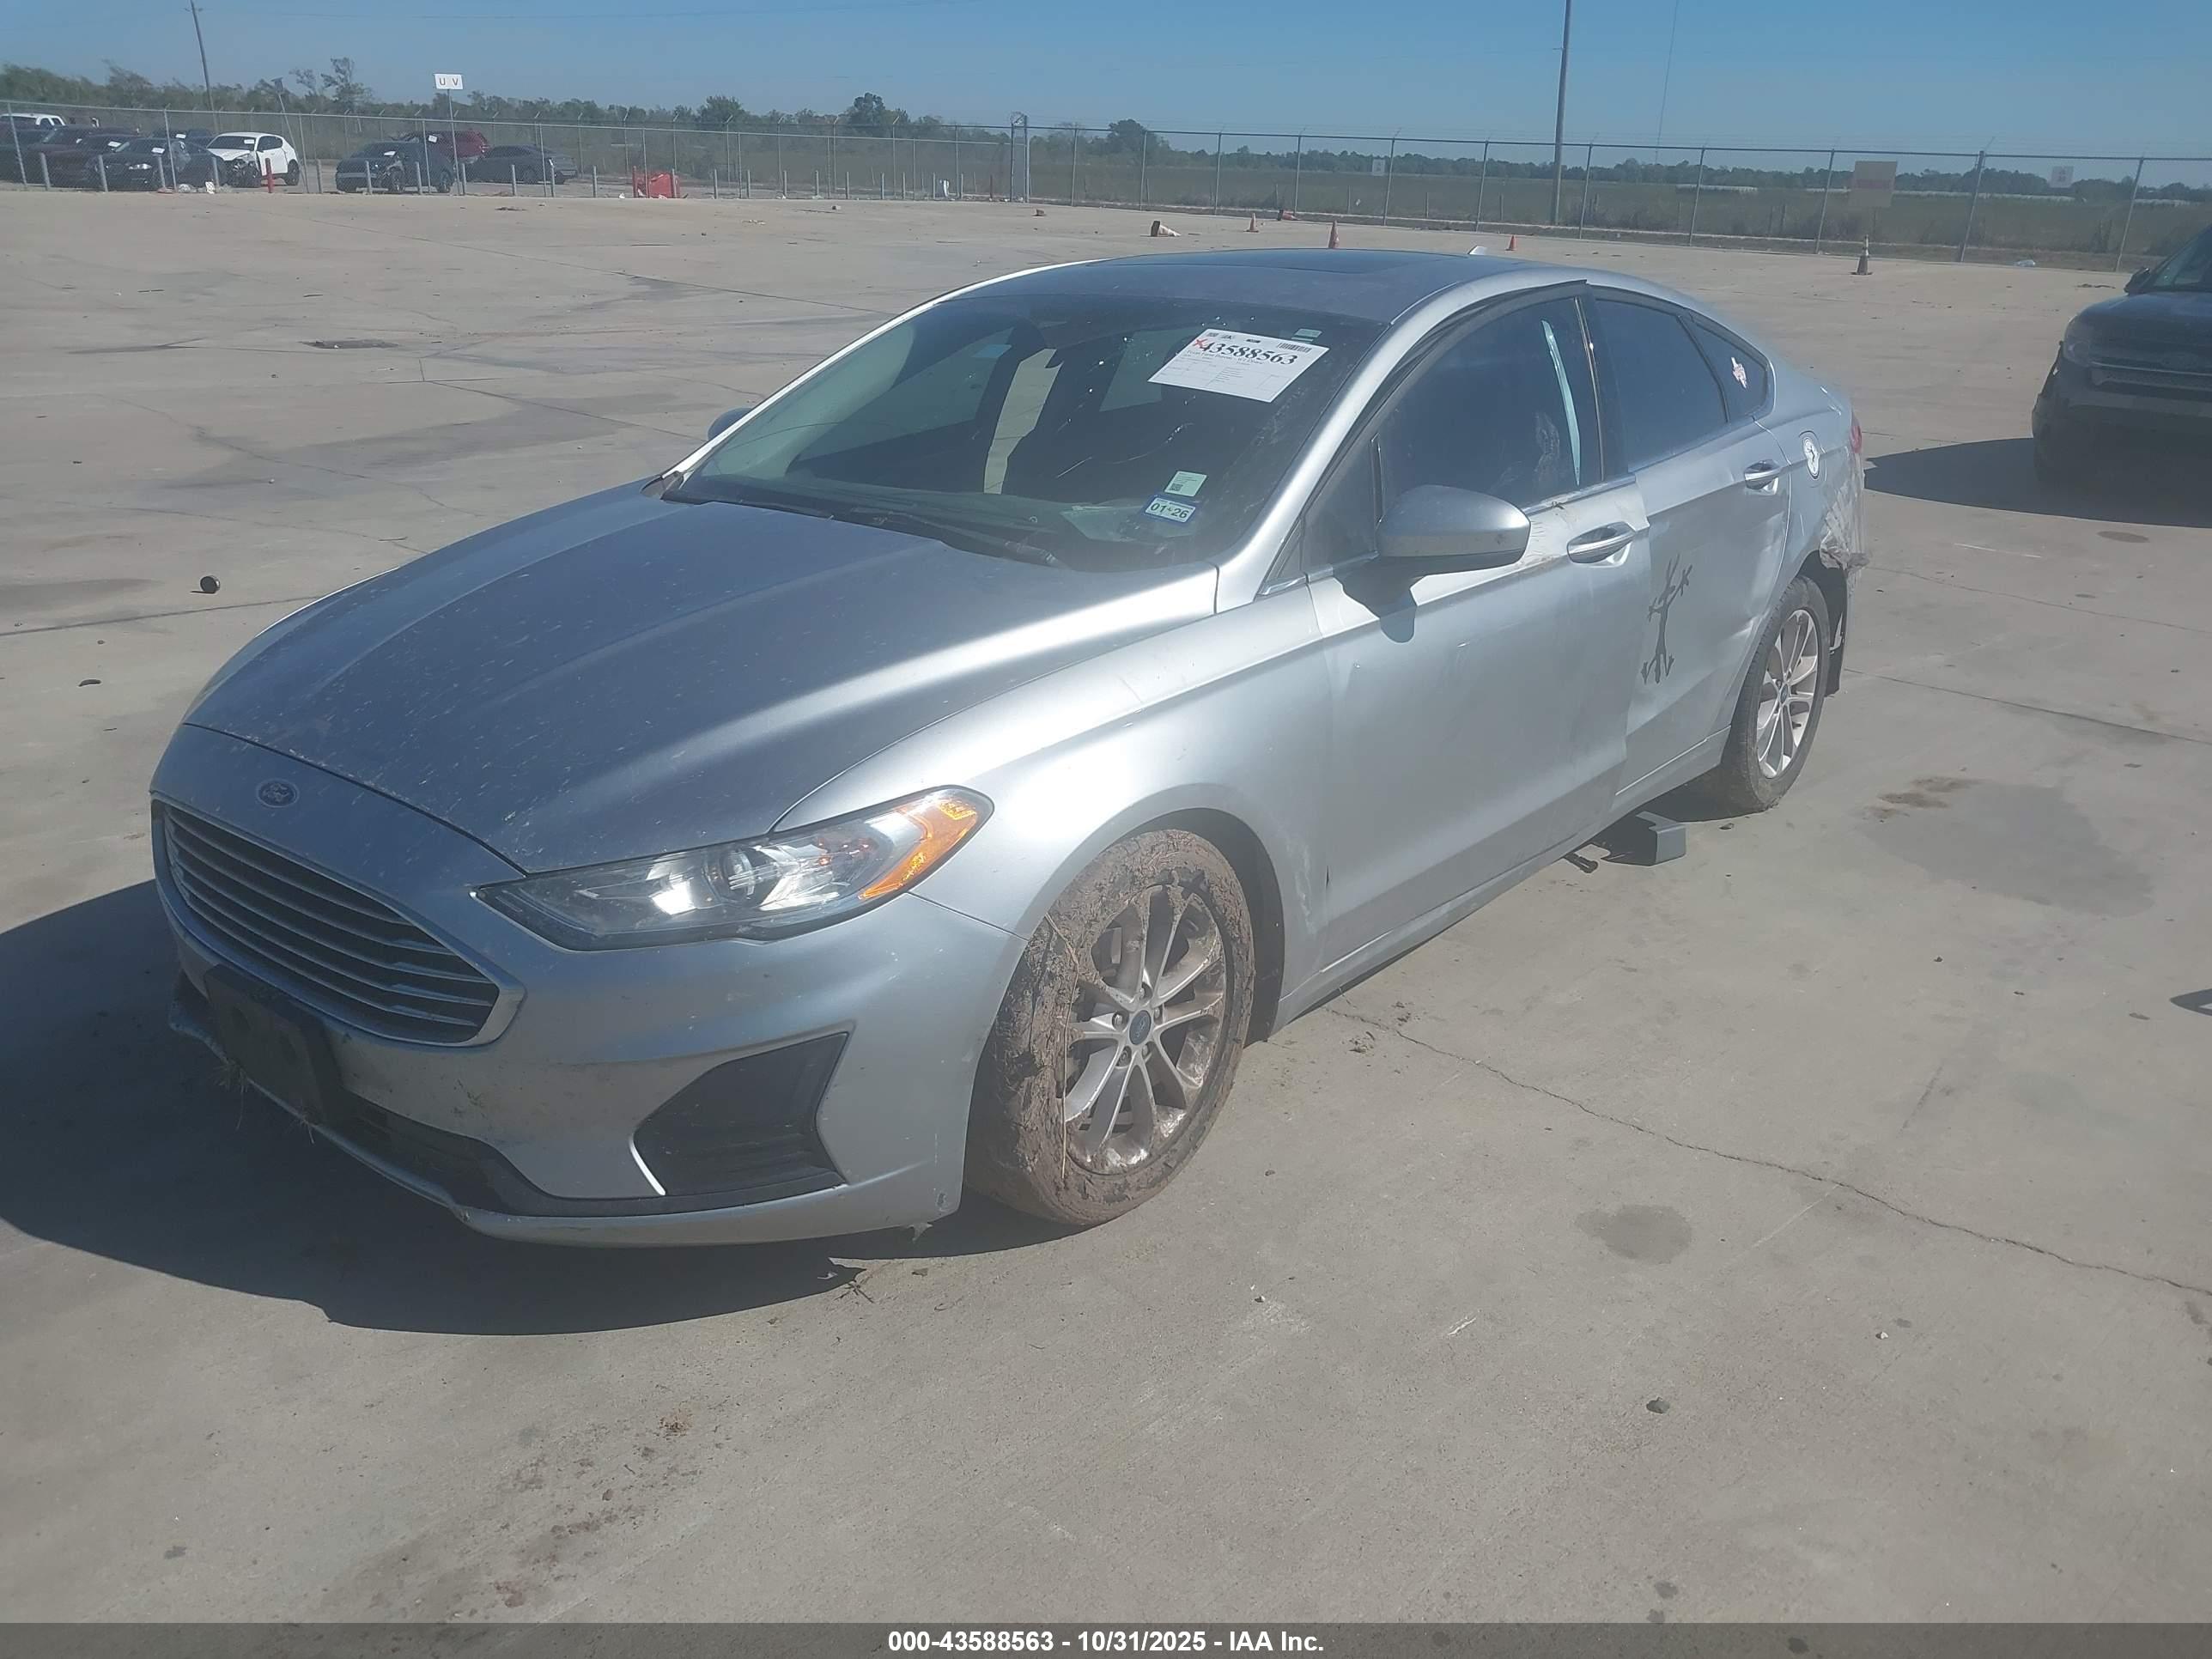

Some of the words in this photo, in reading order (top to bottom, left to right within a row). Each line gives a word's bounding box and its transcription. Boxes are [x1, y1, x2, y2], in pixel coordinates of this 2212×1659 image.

[439, 76, 446, 86] U
[452, 77, 459, 86] V
[1199, 342, 1298, 365] 43588563
